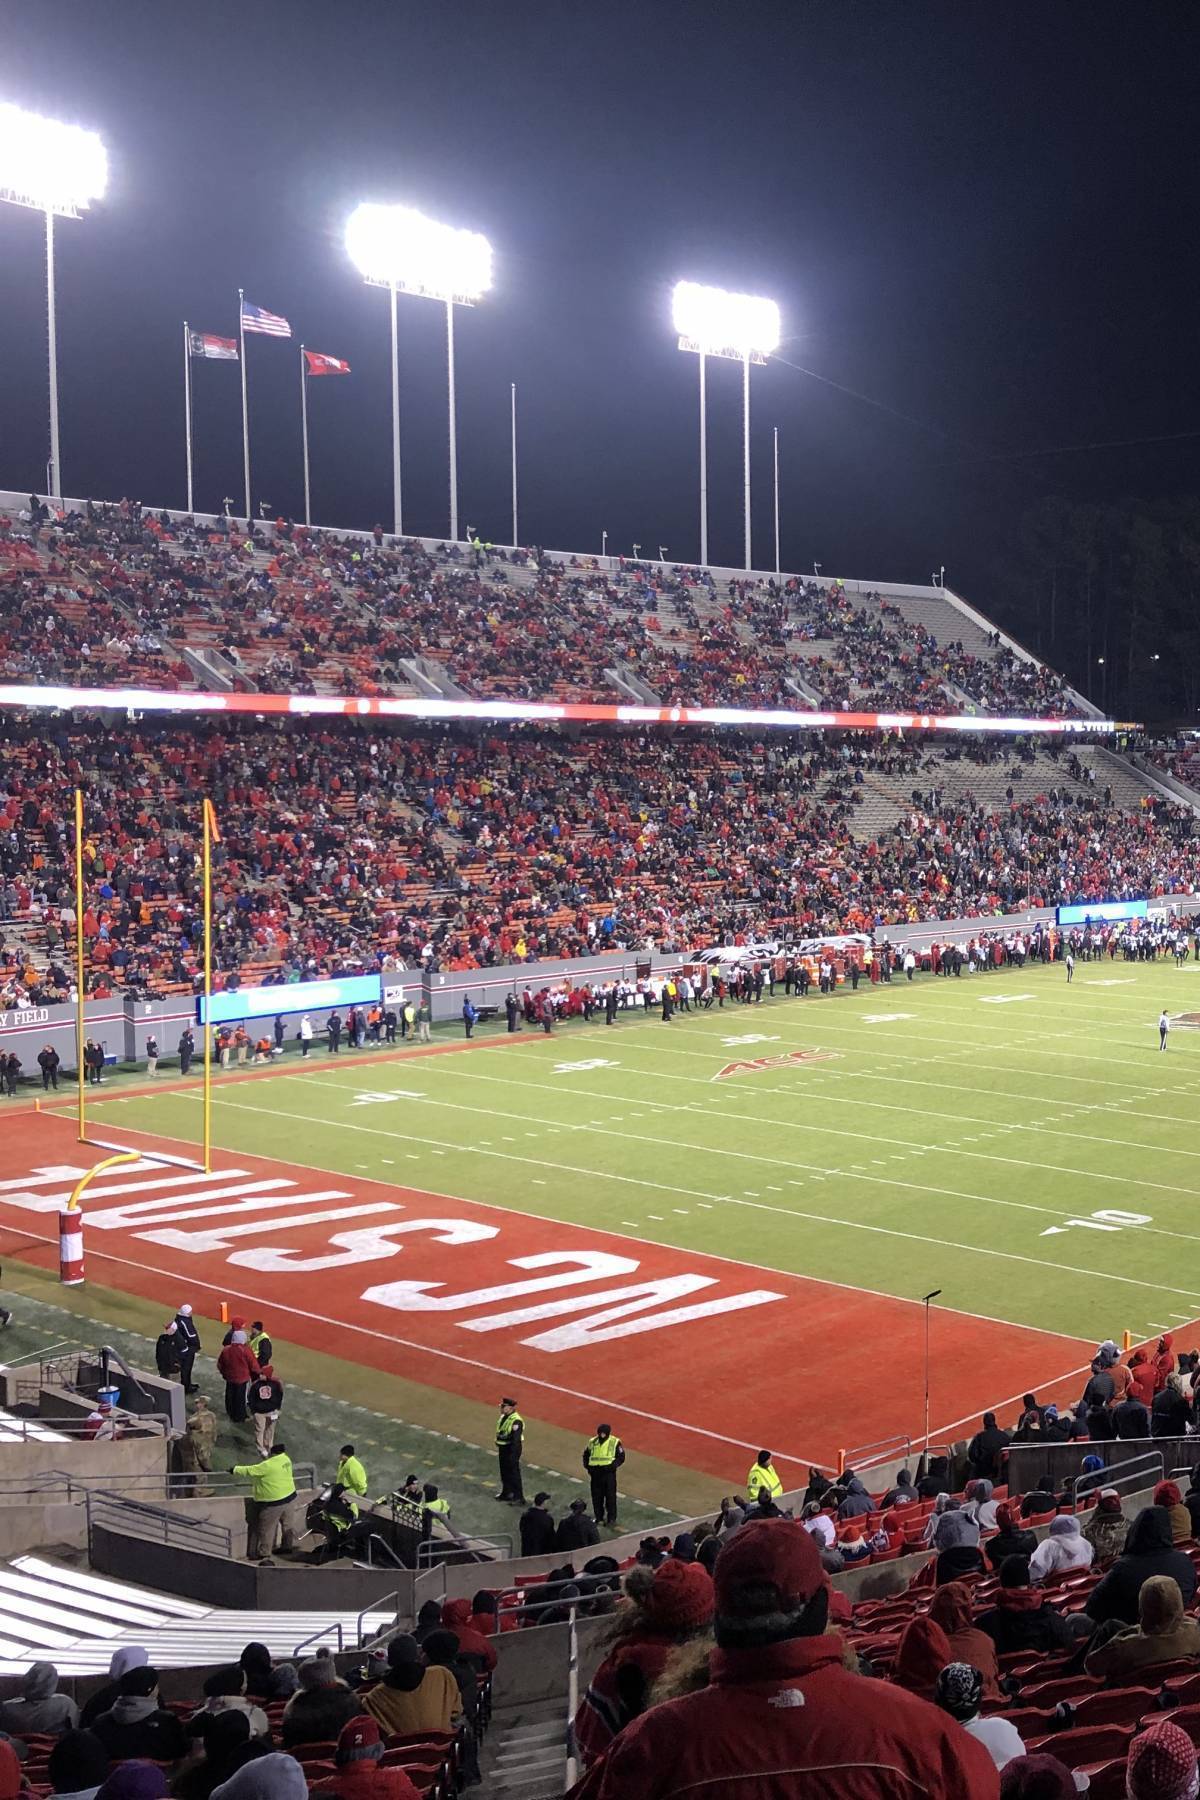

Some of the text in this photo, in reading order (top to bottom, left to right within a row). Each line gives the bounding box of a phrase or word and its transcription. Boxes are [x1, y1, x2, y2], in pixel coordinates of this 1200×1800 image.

[13, 1008, 49, 1025] FIELD
[712, 1048, 842, 1080] ACC
[1064, 1209, 1153, 1231] 10
[360, 1251, 789, 1352] NC
